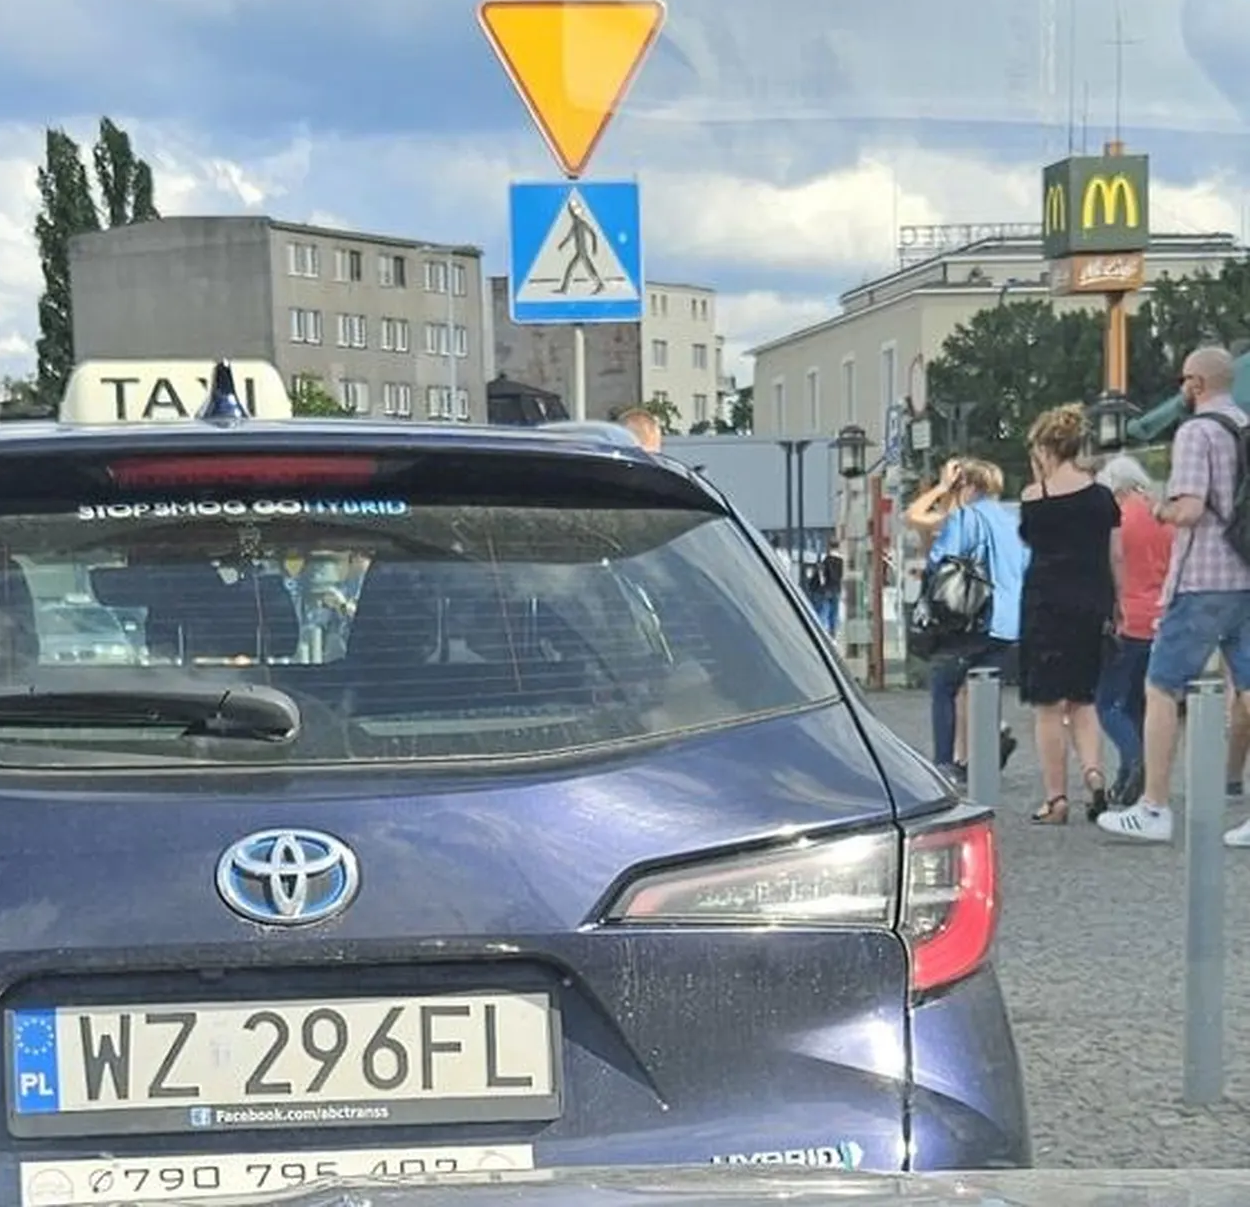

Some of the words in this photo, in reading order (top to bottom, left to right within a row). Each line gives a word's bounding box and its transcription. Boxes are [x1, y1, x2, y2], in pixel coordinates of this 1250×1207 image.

[100, 377, 257, 420] TAI
[79, 1011, 200, 1100] WZ
[243, 1003, 533, 1095] 296FL
[21, 1072, 54, 1097] PL
[124, 1165, 220, 1192] 790
